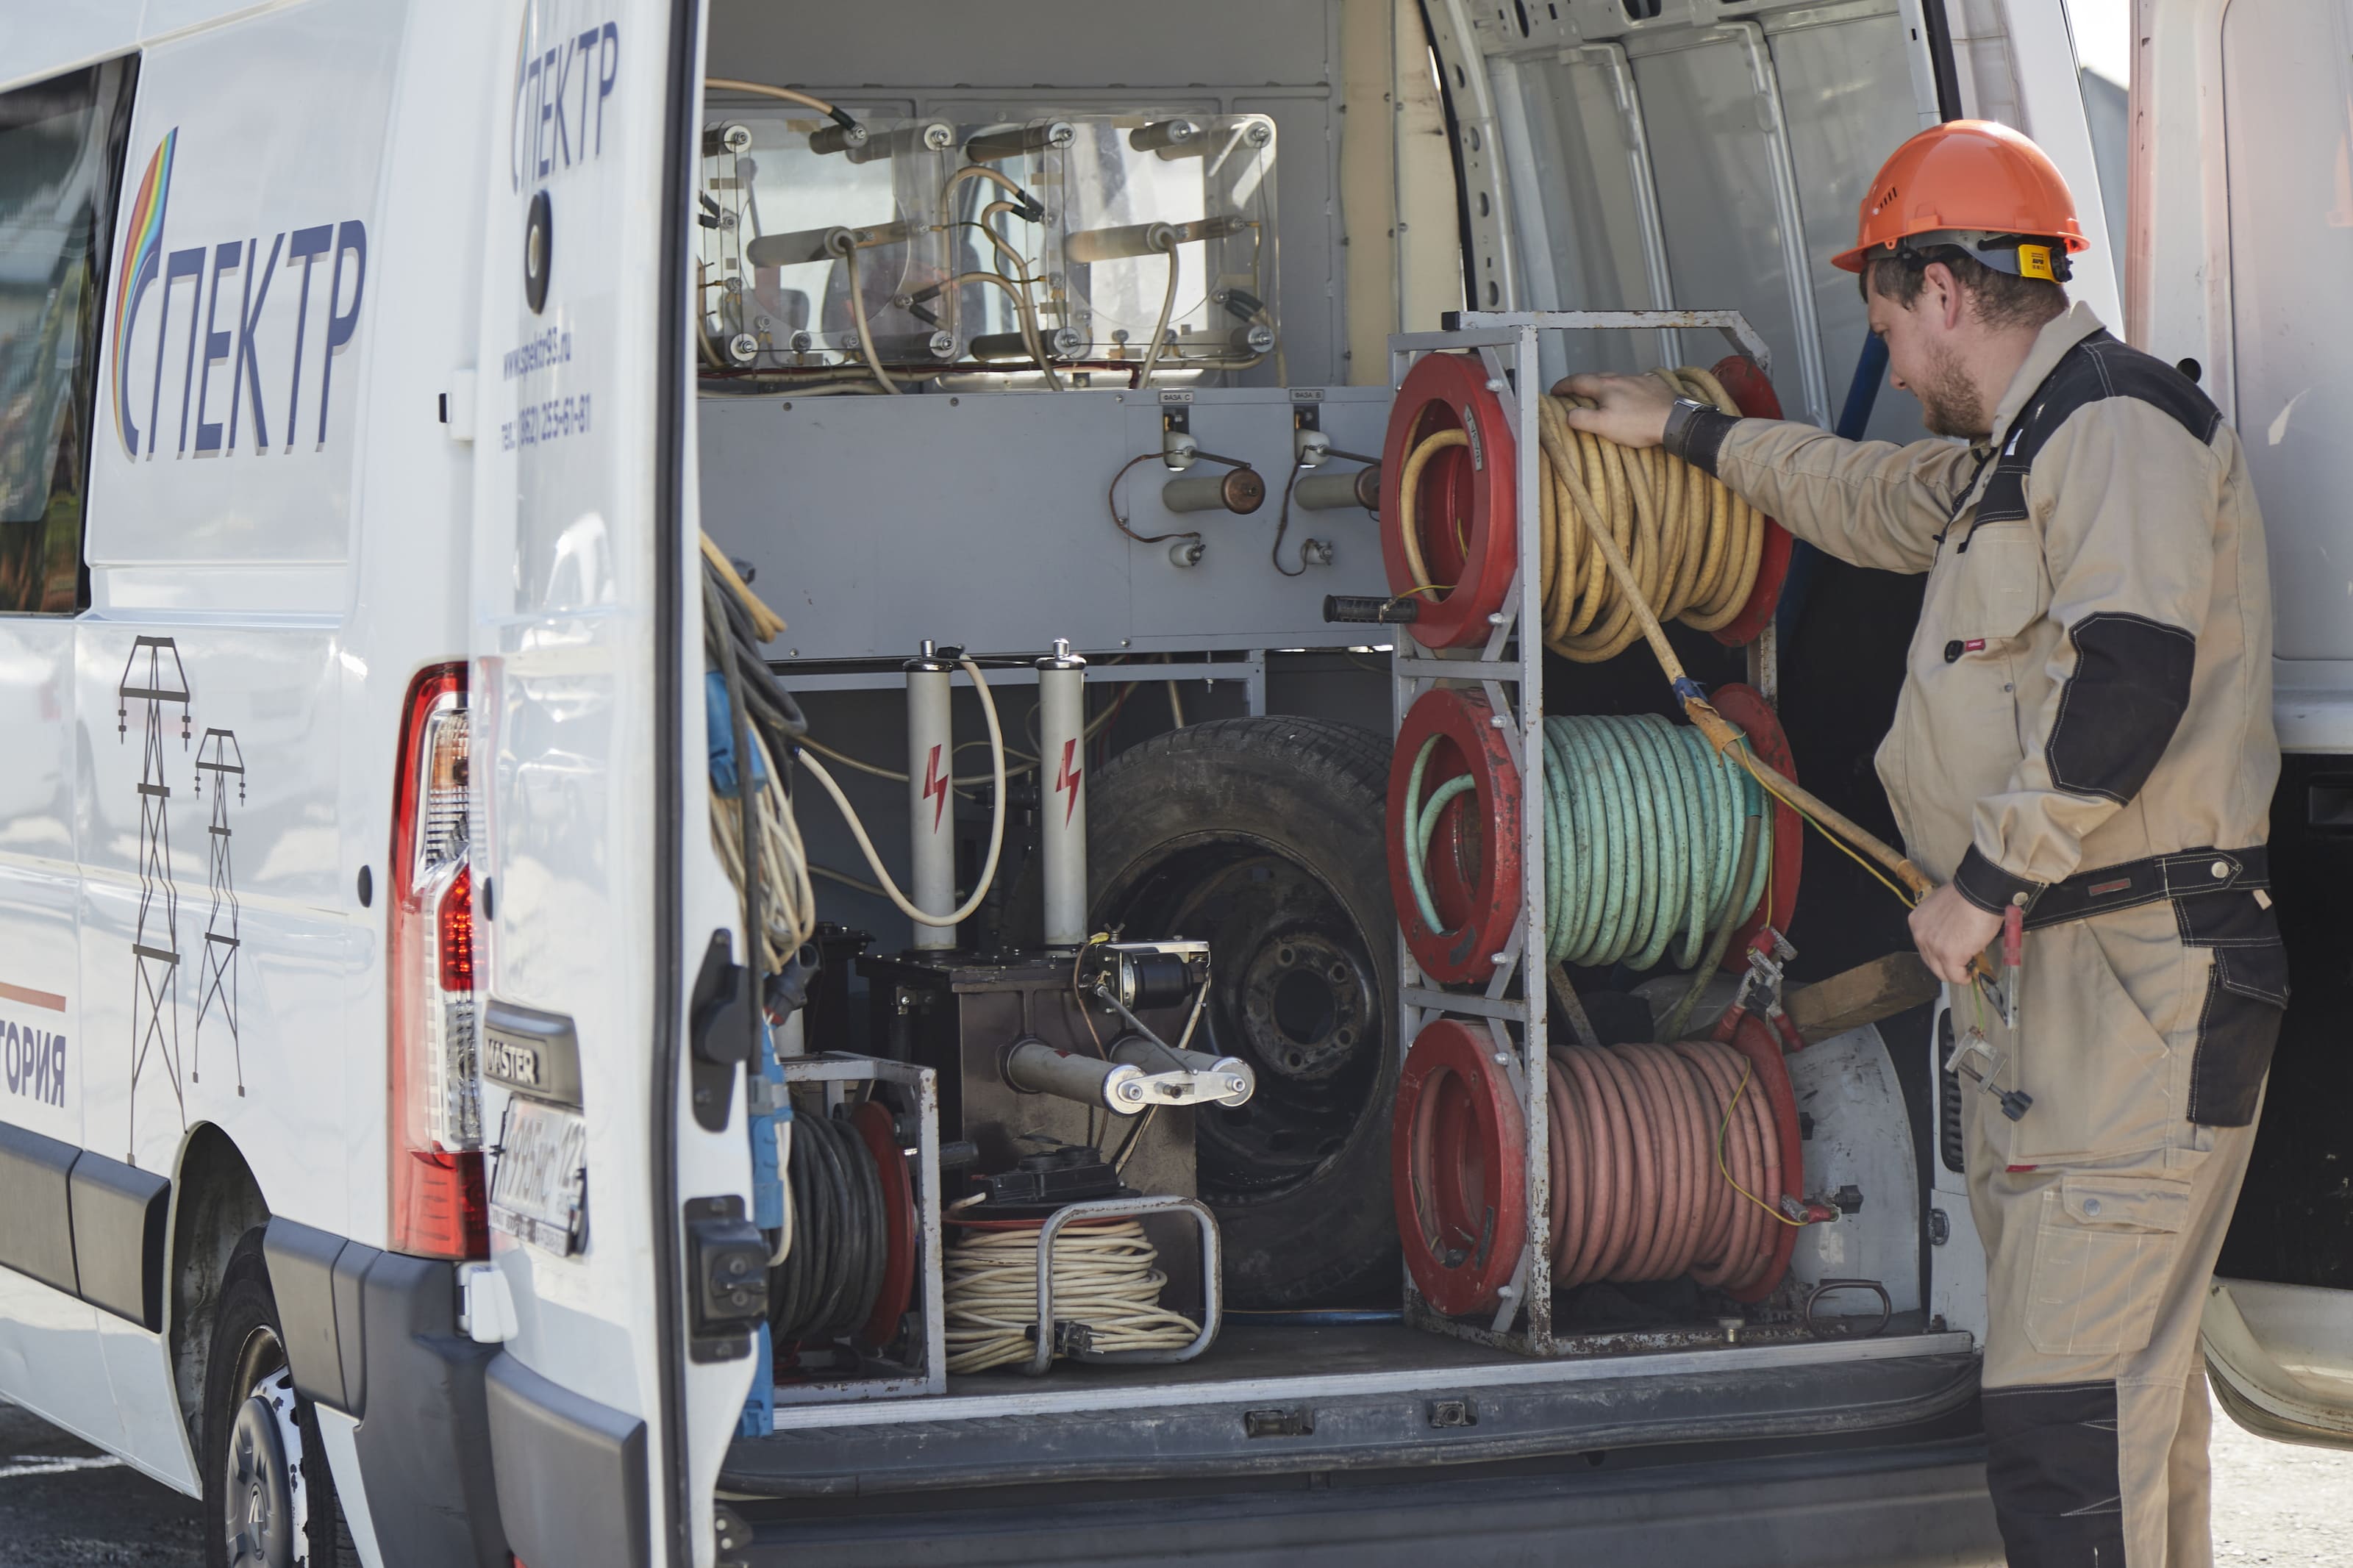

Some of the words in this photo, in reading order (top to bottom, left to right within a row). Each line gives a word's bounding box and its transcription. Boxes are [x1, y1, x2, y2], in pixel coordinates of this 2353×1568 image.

[511, 21, 619, 196] СПЕКТР
[112, 219, 367, 463] СПЕКТР
[488, 1039, 537, 1084] MASTER
